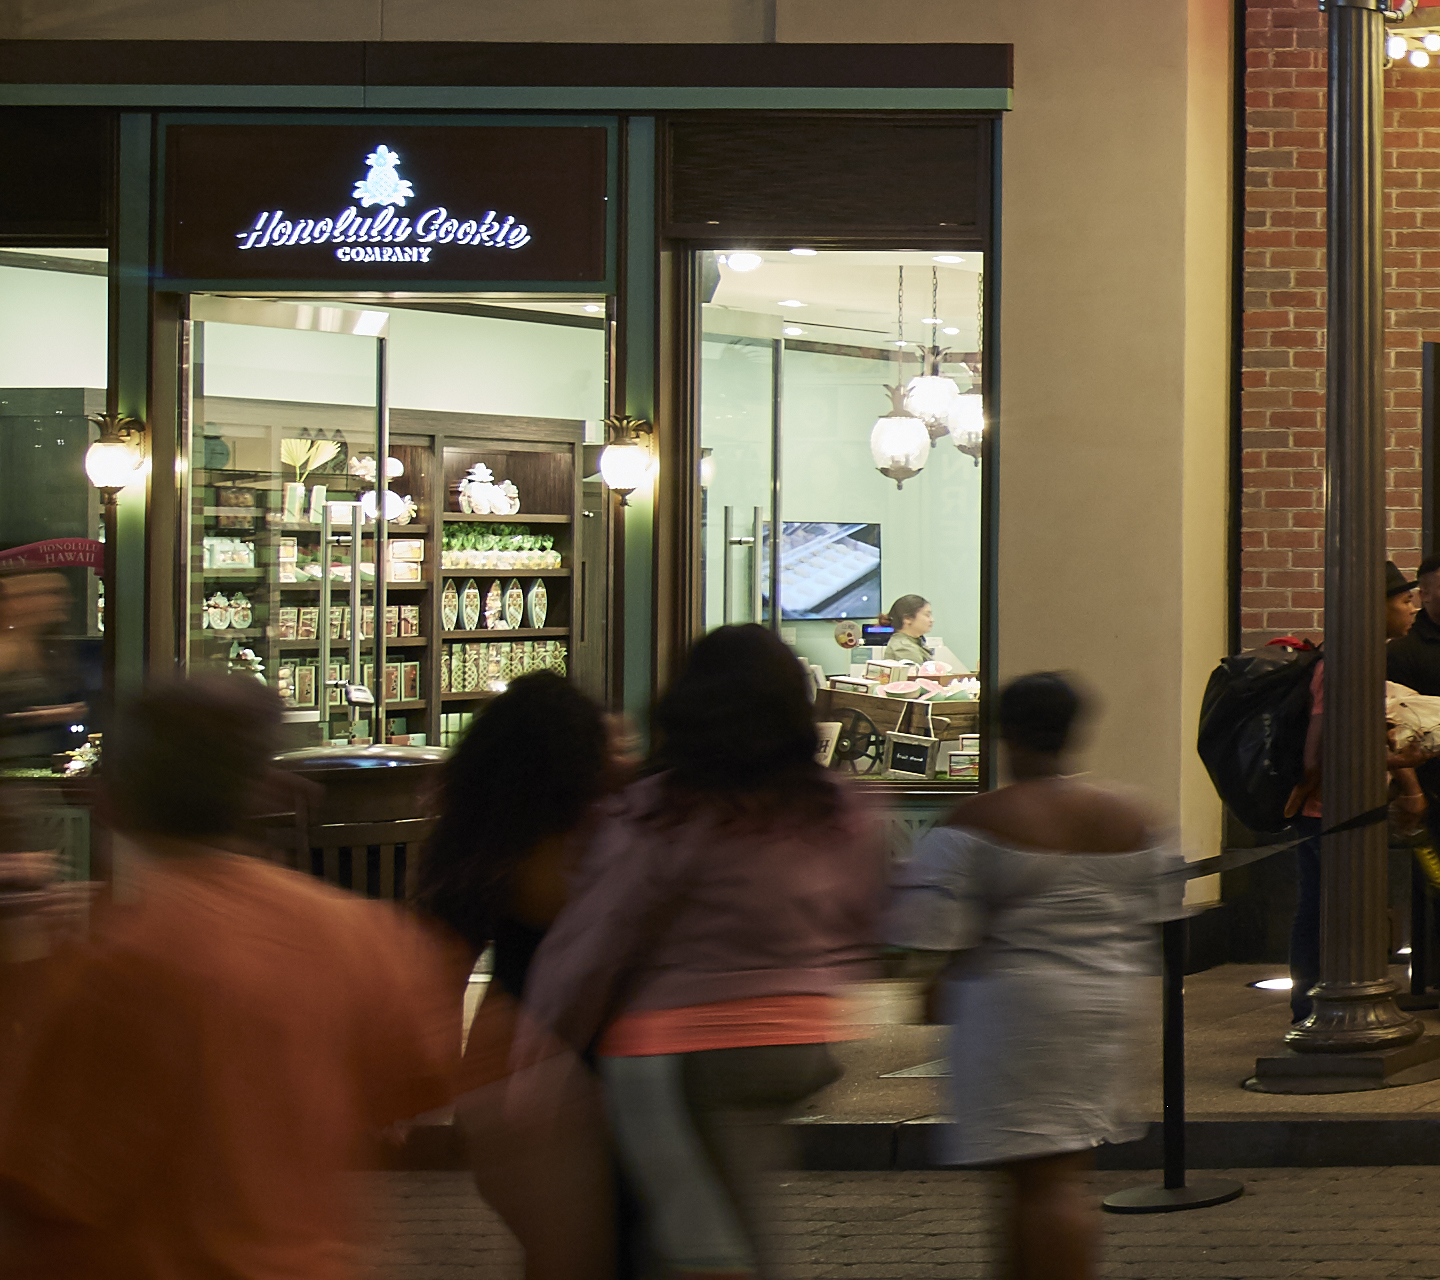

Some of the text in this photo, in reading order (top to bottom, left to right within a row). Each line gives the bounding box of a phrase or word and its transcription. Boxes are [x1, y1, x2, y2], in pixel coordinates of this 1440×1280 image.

[236, 205, 531, 250] Honolulu Cookie
[336, 246, 432, 263] COMPANY
[39, 543, 100, 553] HONOLULU
[46, 552, 95, 563] HAWAII
